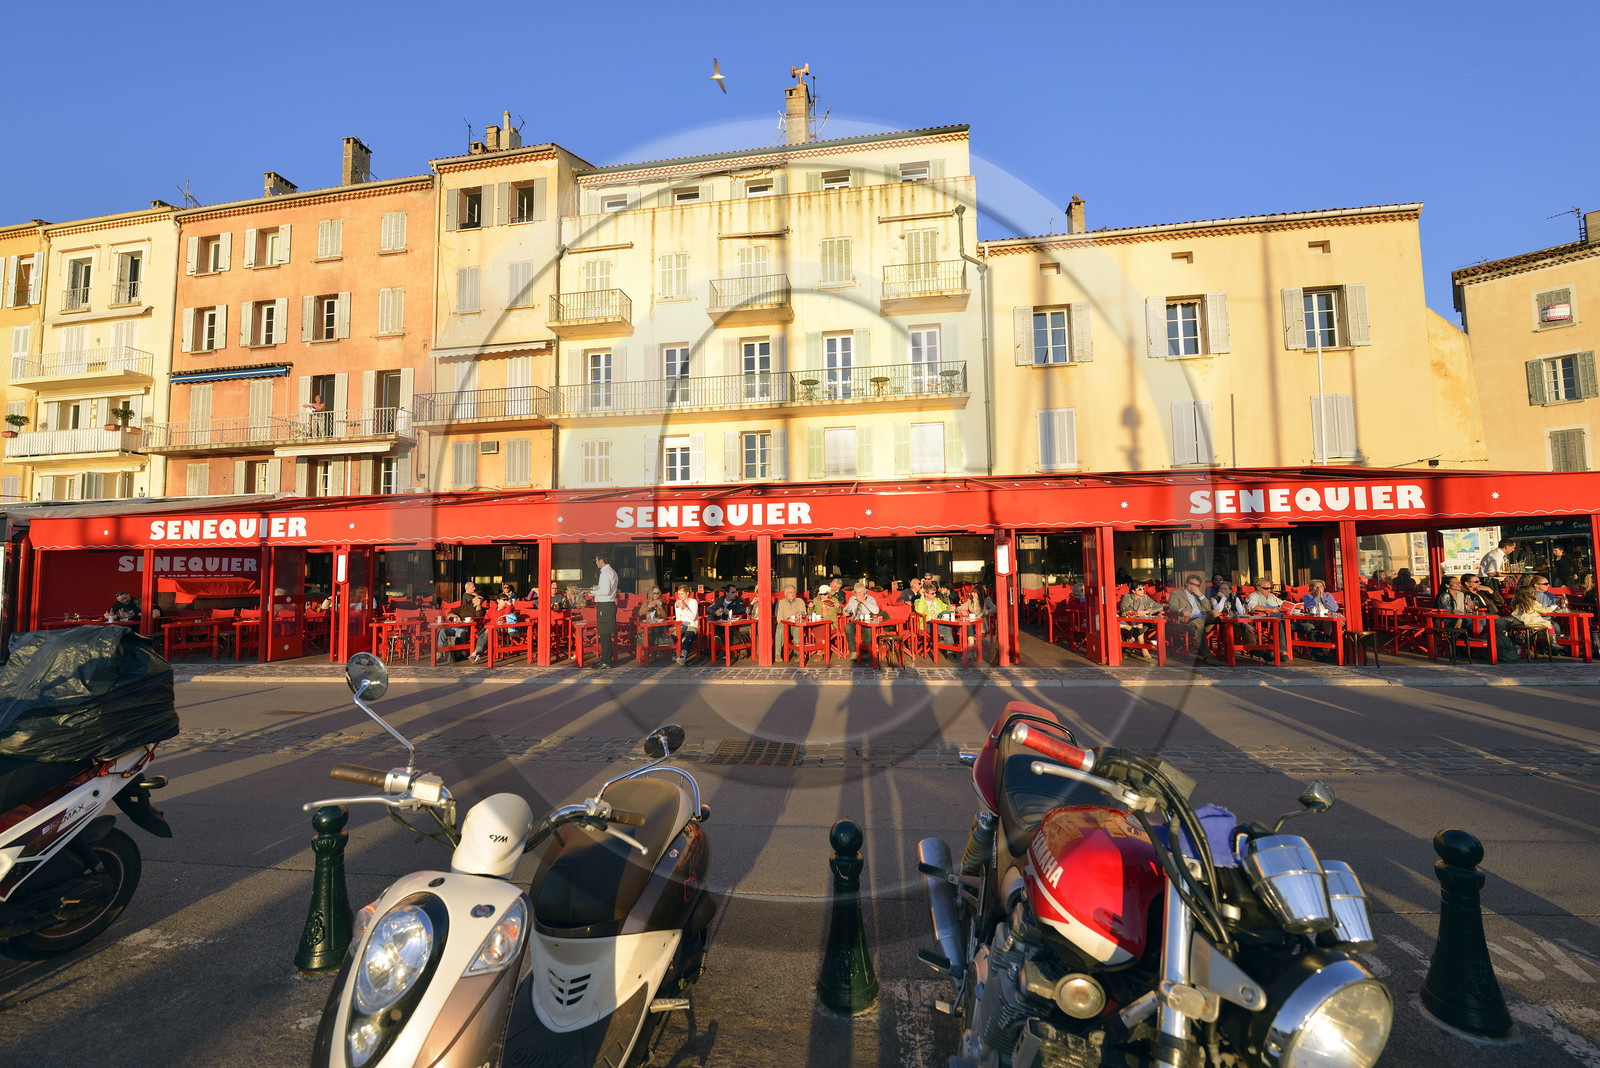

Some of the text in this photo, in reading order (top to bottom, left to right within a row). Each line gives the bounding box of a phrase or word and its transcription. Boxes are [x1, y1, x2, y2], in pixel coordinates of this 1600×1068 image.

[1189, 484, 1426, 514] SENEQUIER
[149, 516, 308, 541] SENEQUIER
[615, 502, 812, 528] SENEQUIER
[1031, 829, 1064, 890] YAMAHA
